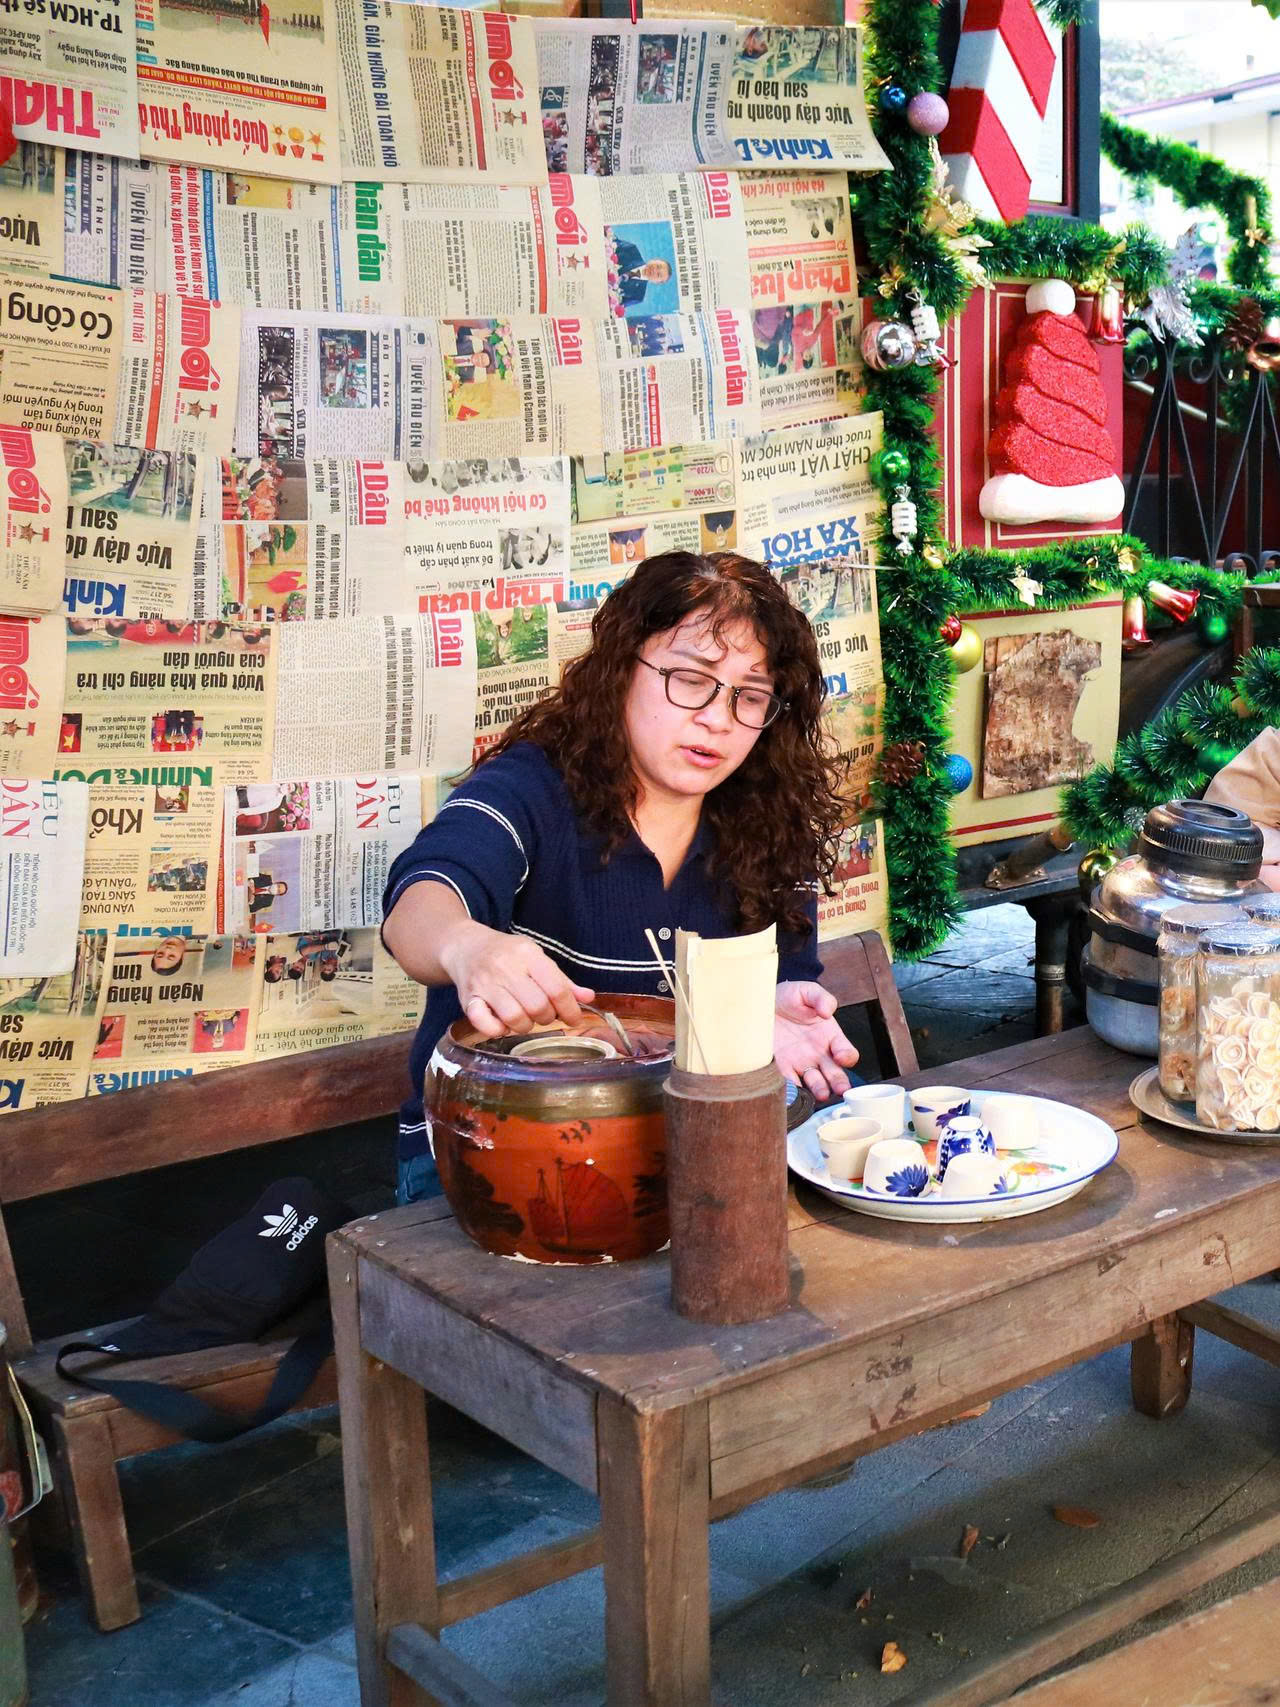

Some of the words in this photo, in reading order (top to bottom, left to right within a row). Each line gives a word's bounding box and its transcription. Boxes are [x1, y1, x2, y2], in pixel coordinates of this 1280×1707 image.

[50, 1, 122, 33] TP.HCM
[364, 25, 384, 48] GIẢI
[376, 114, 397, 142] TOÁN
[755, 81, 779, 99] bão
[149, 106, 182, 141] Thủ
[183, 102, 230, 146] phòng
[796, 102, 820, 123] dậy
[825, 103, 853, 124] Vực
[232, 119, 268, 155] Quốc
[355, 181, 384, 230] hân
[707, 173, 732, 218] Dân
[130, 228, 151, 250] TÀU
[128, 255, 148, 284] ĐIỆN
[357, 233, 387, 281] dân
[788, 259, 851, 294] Pháp
[8, 292, 75, 332] công
[80, 311, 112, 340] Có
[557, 319, 582, 365] Dân
[715, 310, 740, 363] nhân
[726, 365, 747, 406] dân
[800, 454, 829, 477] VẬT
[833, 447, 871, 471] CHẬT
[364, 475, 389, 525] Dân
[404, 500, 422, 519] bỏ
[424, 498, 450, 520] thể
[453, 495, 500, 518] không
[503, 491, 526, 514] hội
[81, 508, 118, 532] sau
[93, 536, 130, 563] dậy
[136, 540, 172, 569] Vực
[63, 578, 126, 617] Kinh
[438, 619, 463, 668] Dân
[194, 651, 234, 670] người
[240, 653, 265, 672] của
[77, 673, 97, 692] trả
[130, 671, 165, 689] năng
[170, 673, 196, 691] khả
[232, 671, 264, 691] Vượt
[1, 779, 40, 839] DÂN
[88, 808, 143, 839] Khổ
[113, 964, 142, 982] tìm
[107, 986, 153, 1005] hàng
[159, 982, 204, 1002] Ngân
[38, 1036, 74, 1061] Vực
[286, 1216, 319, 1251] adidas
